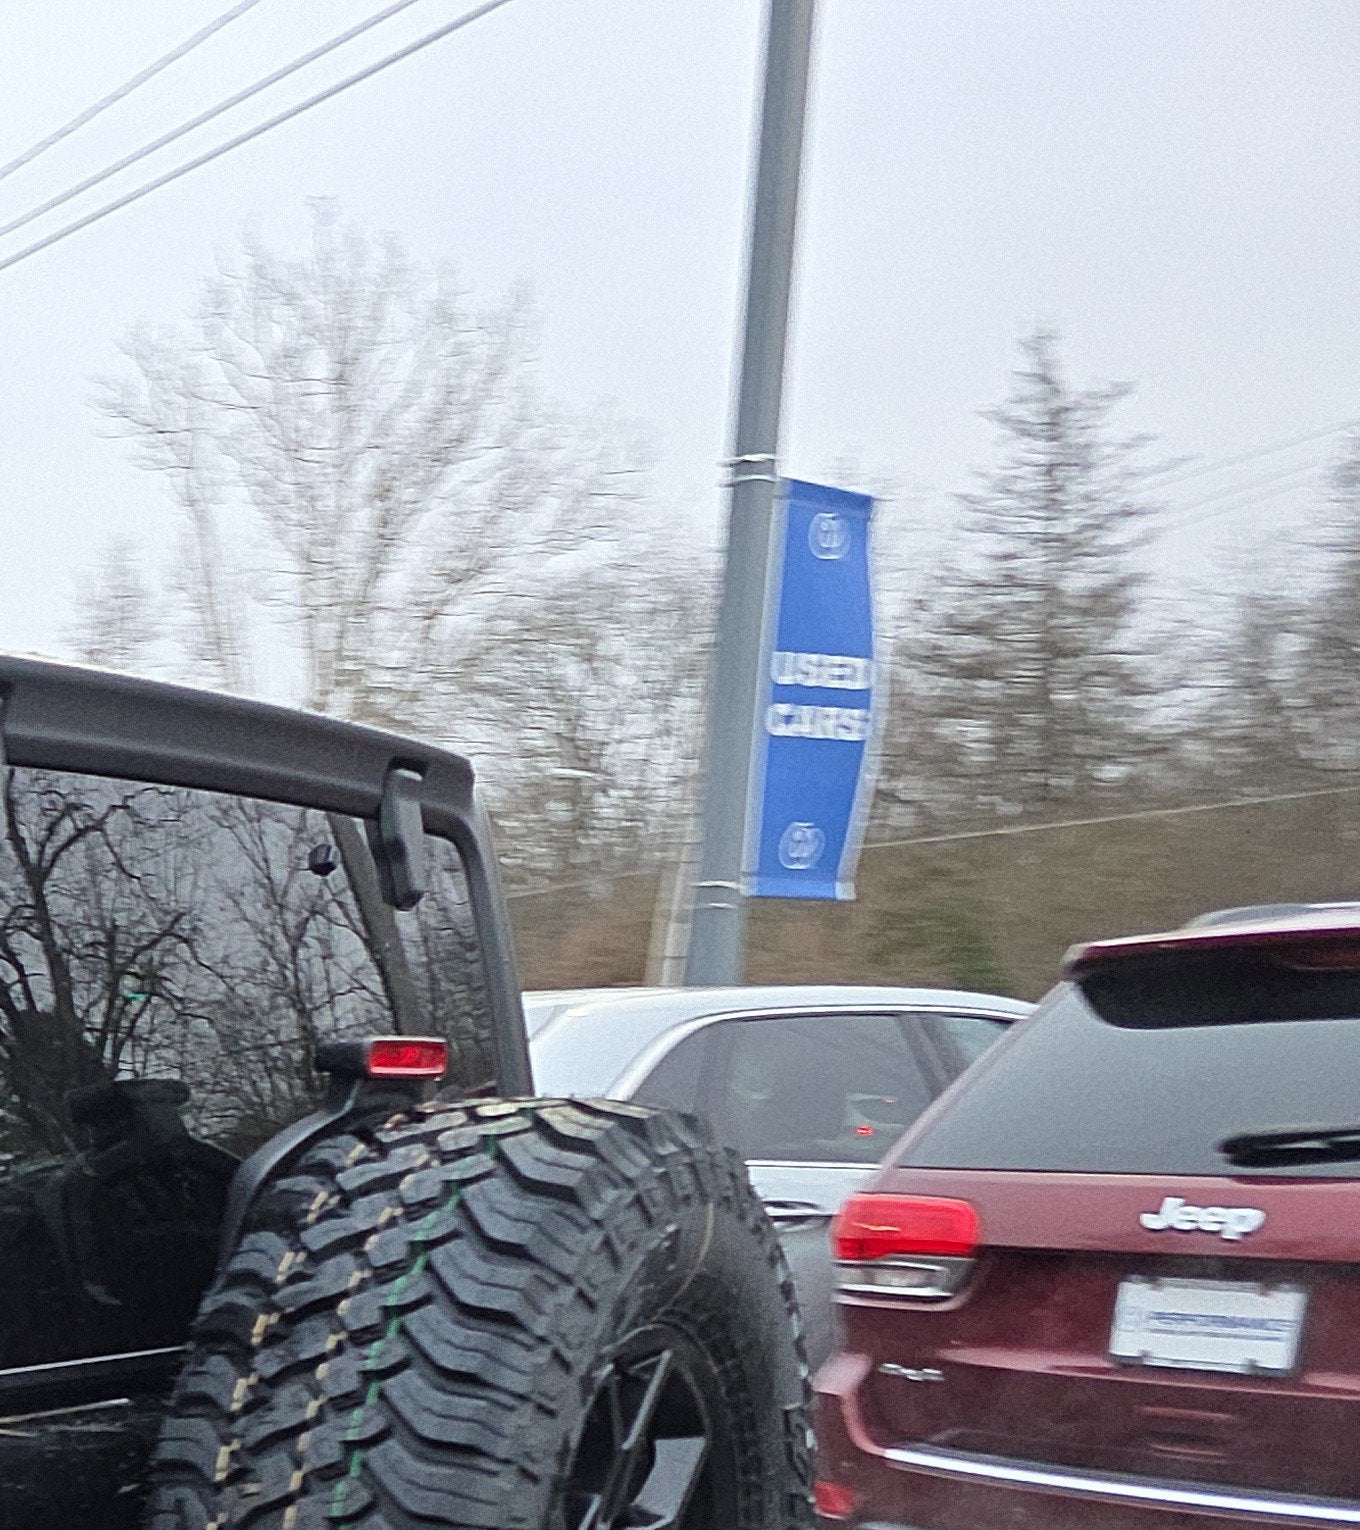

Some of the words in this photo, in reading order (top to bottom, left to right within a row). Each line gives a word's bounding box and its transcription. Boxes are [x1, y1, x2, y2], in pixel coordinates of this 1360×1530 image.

[769, 651, 872, 690] USED
[766, 703, 872, 741] CARS
[1140, 1196, 1266, 1240] Jeep
